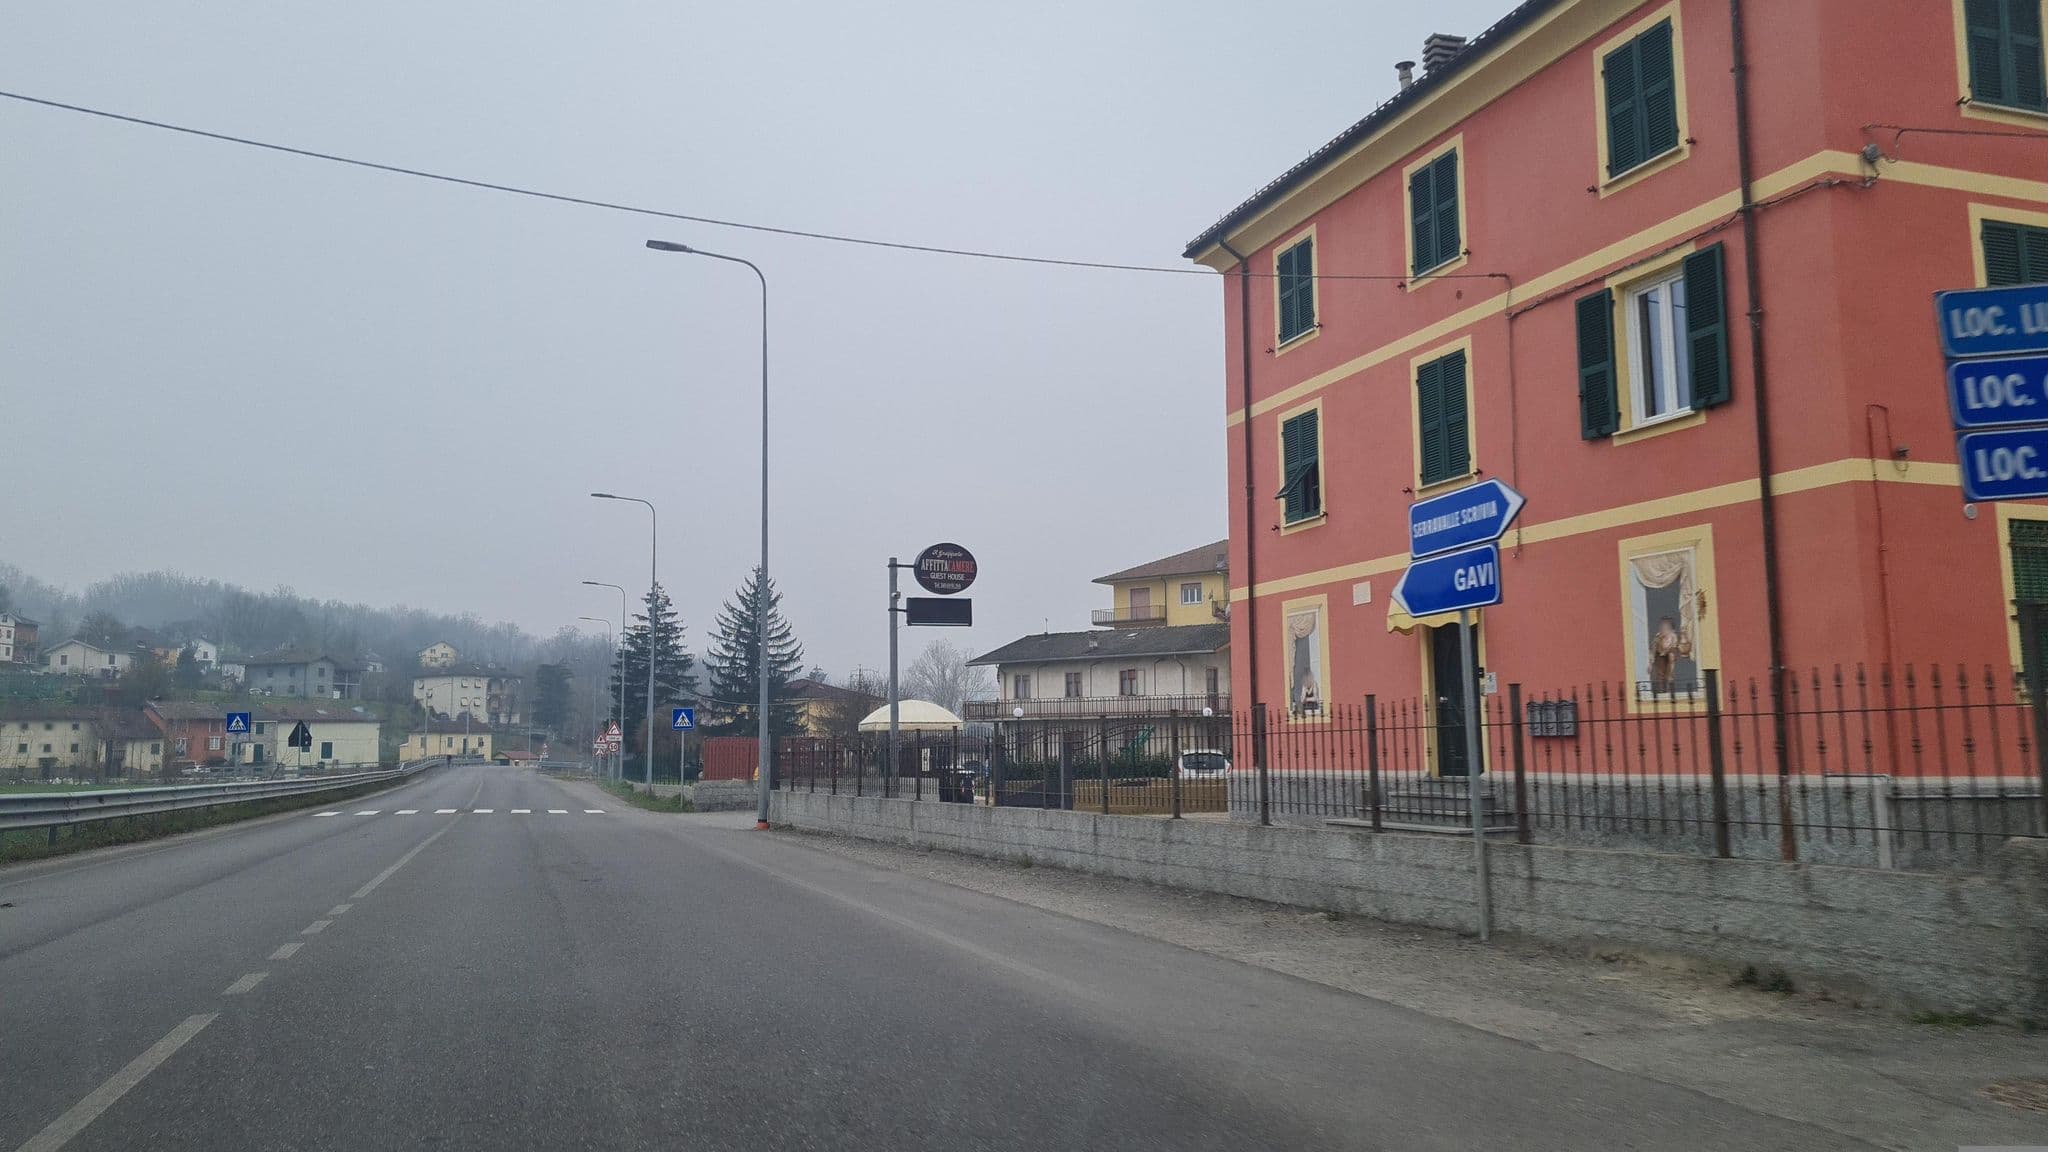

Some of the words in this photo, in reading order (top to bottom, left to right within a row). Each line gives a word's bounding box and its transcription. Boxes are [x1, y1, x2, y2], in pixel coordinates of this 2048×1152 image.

[1951, 306, 2016, 339] LOC.
[1963, 373, 2036, 410] LOC.
[1974, 446, 2047, 482] LOC.
[1413, 511, 1461, 538] SERRAVALLE
[1461, 500, 1498, 525] SCRIVIA
[921, 558, 975, 573] AFFITTACAMERE
[930, 572, 946, 580] GUEST
[948, 573, 965, 581] HOUSE
[1454, 562, 1494, 592] GAVI
